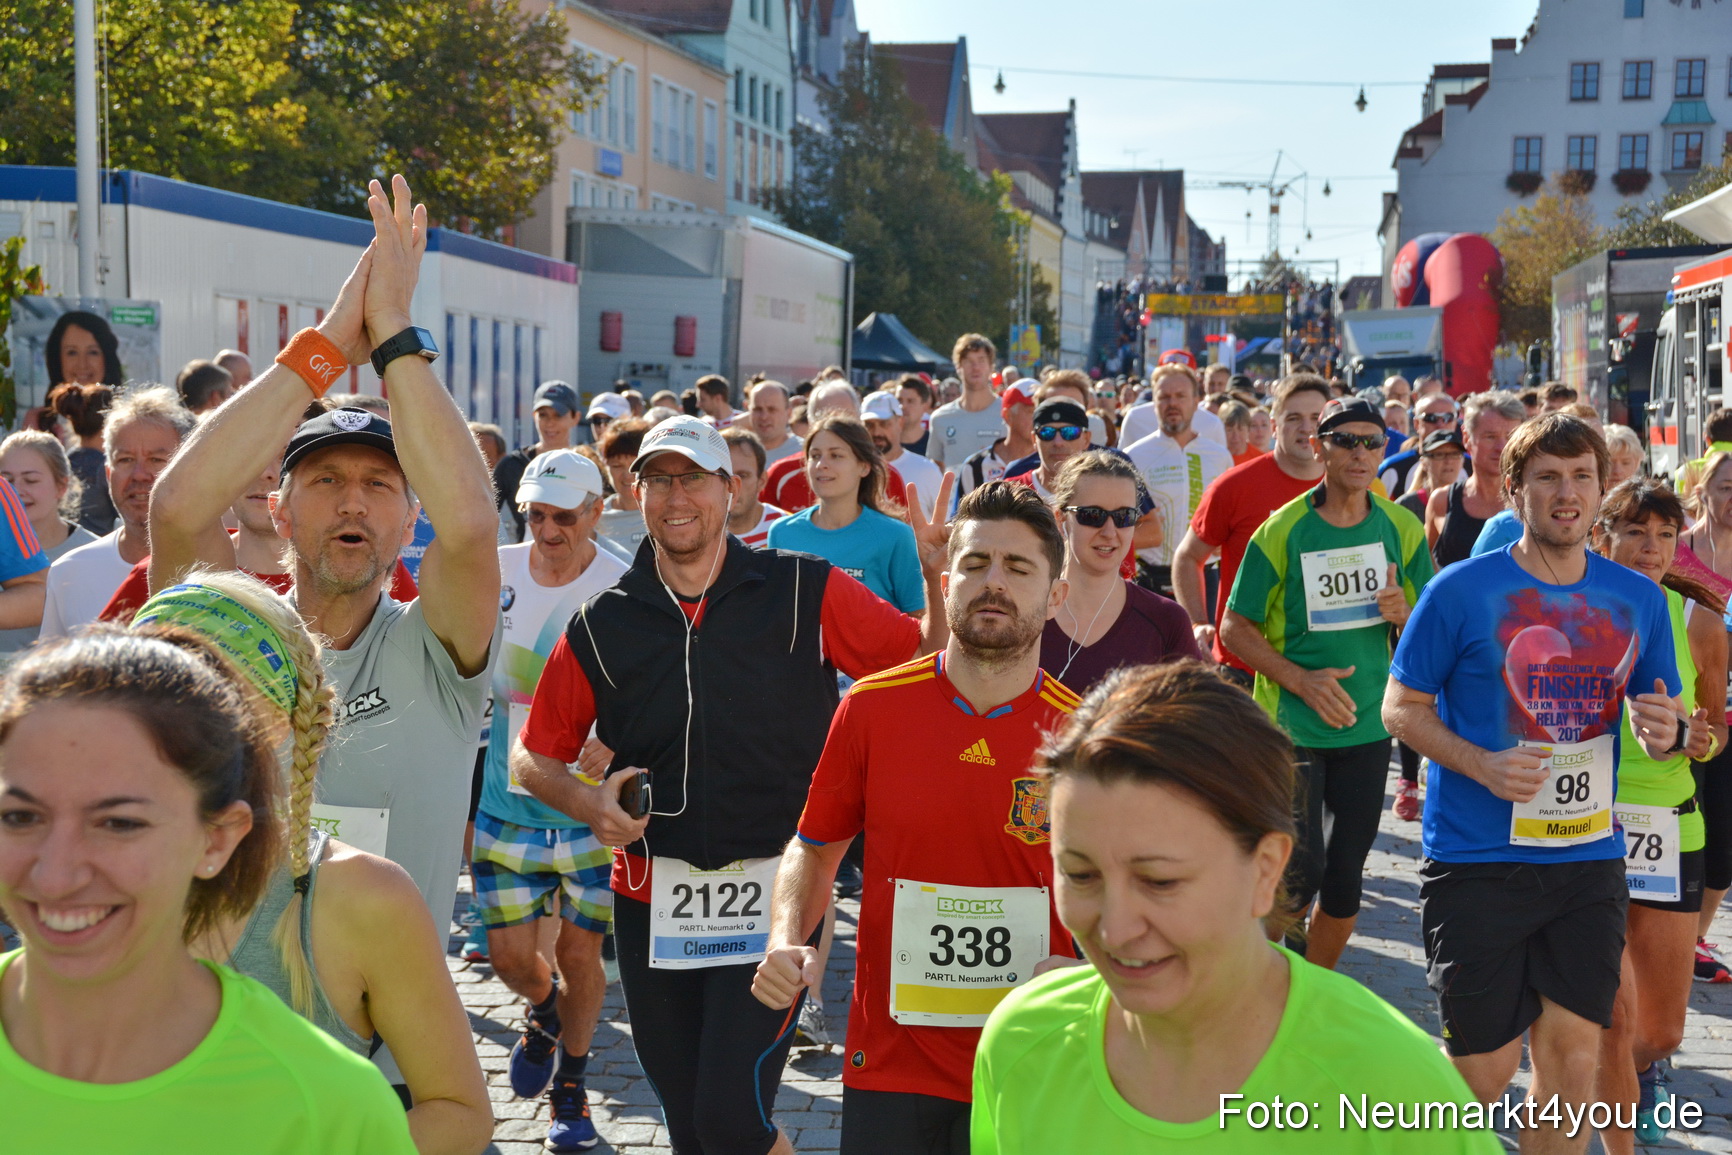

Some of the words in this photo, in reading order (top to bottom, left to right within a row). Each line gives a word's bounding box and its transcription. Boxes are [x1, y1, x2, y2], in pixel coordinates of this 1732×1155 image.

[1328, 553, 1365, 567] BOCK
[1318, 567, 1379, 598] 3018
[1527, 664, 1551, 673] DATEV
[1552, 664, 1594, 674] CHALLENGE
[1527, 675, 1613, 700] FINISHER
[364, 705, 391, 720] concepts
[1527, 701, 1539, 710] 3.8
[1540, 701, 1552, 710] KM
[1557, 701, 1569, 710] 180
[1571, 701, 1583, 710] KM
[1536, 712, 1569, 726] RELAY
[1573, 712, 1600, 726] TEAM
[959, 753, 996, 766] adidas
[1553, 749, 1593, 766] BOCK
[1555, 771, 1590, 805] 98
[1565, 806, 1592, 815] Neumarkt
[1616, 811, 1651, 824] OCK
[1546, 819, 1592, 835] Manuel
[671, 881, 762, 918] 2122
[937, 897, 1005, 914] BOCK
[679, 924, 705, 932] PARTL
[707, 923, 744, 931] Neumarkt
[683, 940, 747, 956] Clemens
[929, 924, 1012, 968] 338
[901, 953, 907, 962] C
[925, 972, 956, 982] PARTL
[958, 974, 1003, 983] Neumarkt
